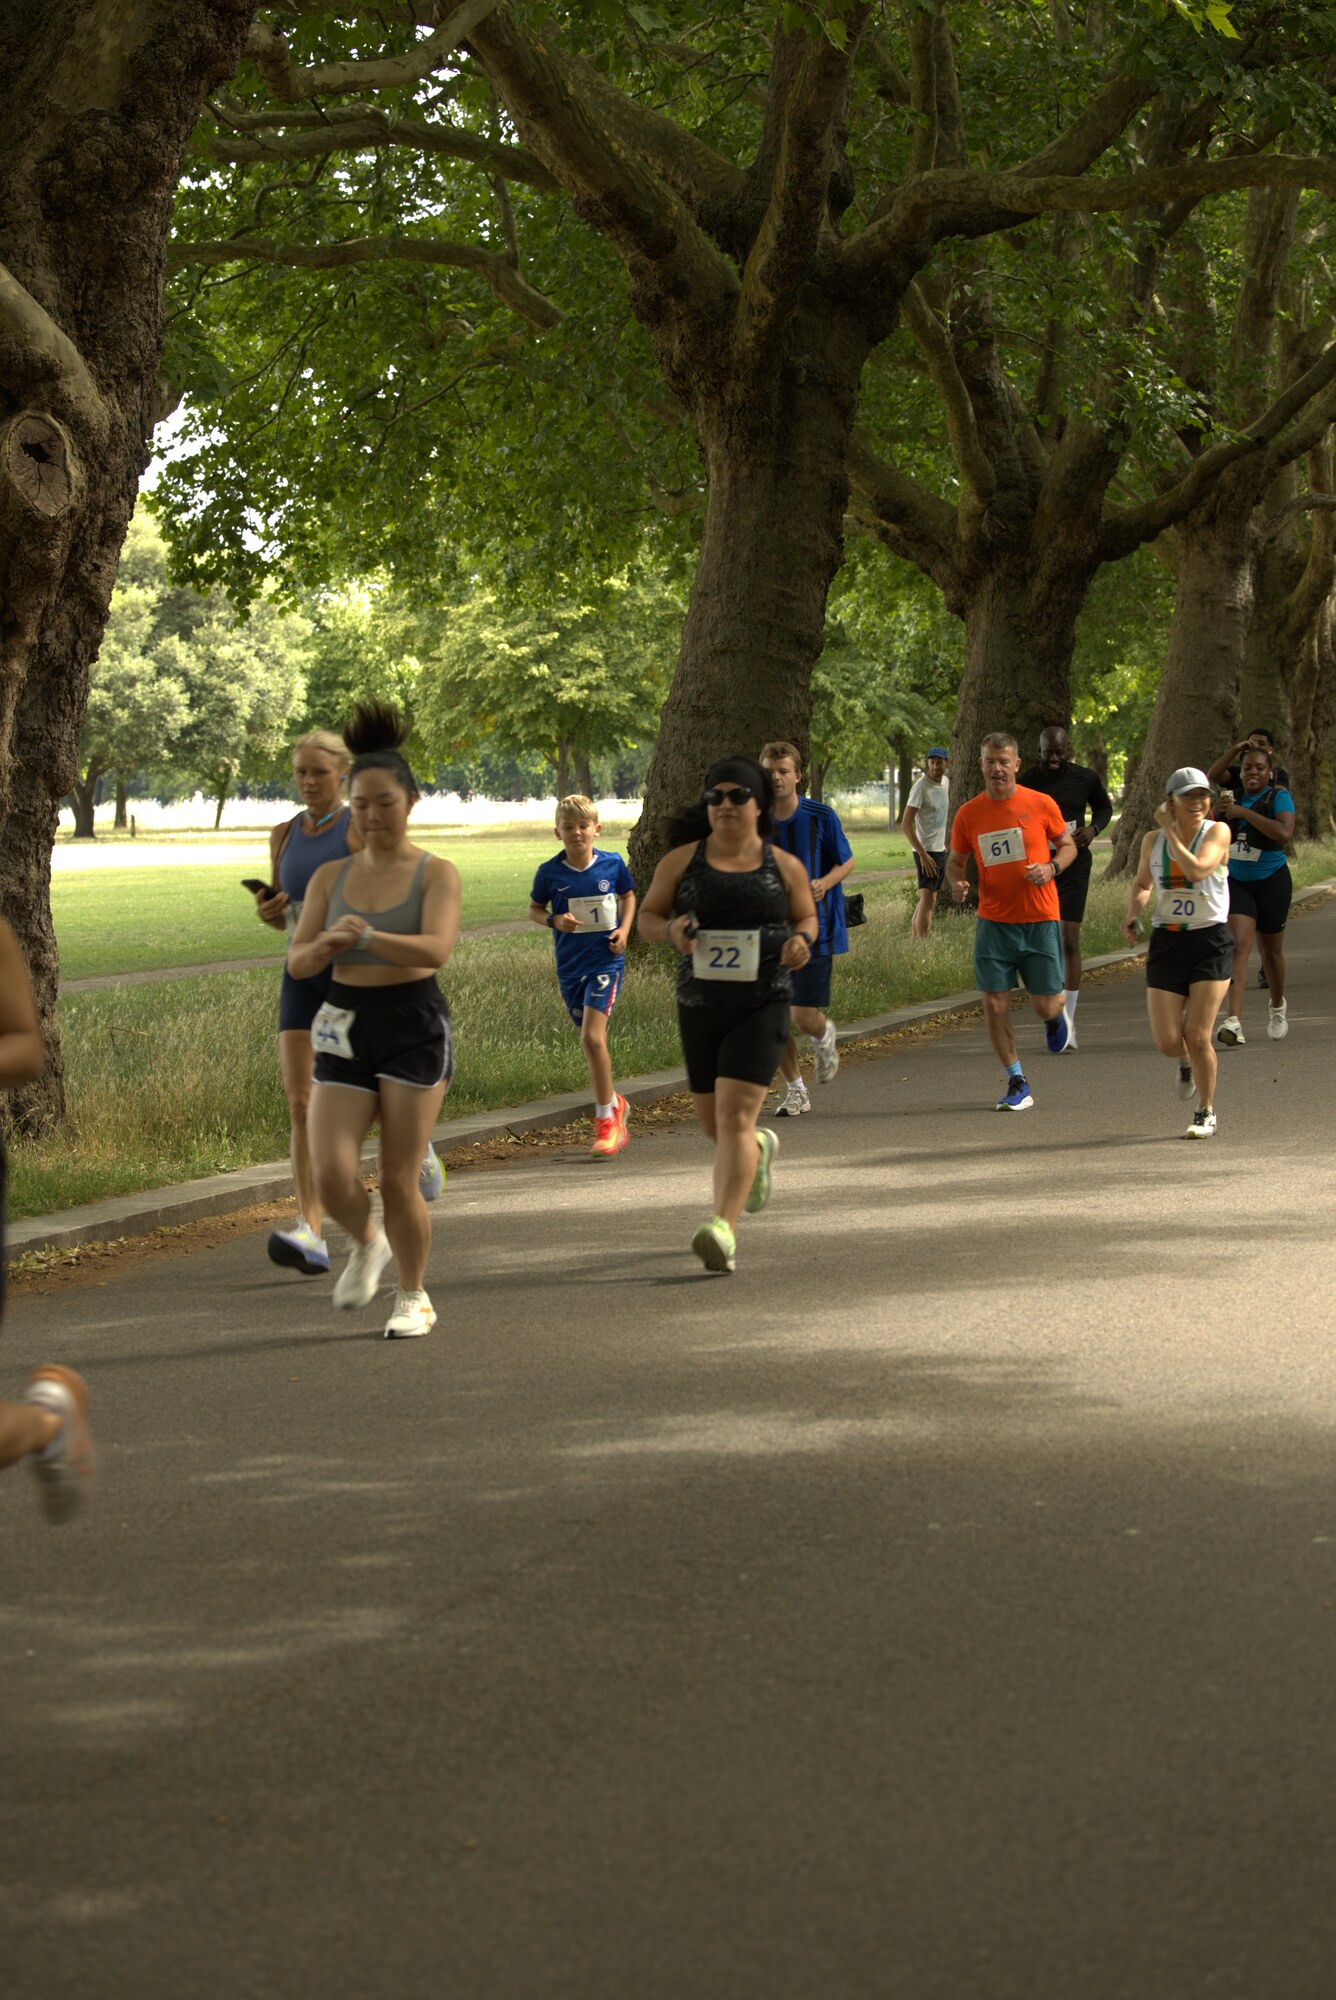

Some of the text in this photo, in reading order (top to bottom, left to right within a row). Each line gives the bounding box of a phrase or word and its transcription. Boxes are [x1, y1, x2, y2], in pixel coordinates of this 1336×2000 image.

[991, 840, 1011, 857] 61
[590, 907, 599, 923] 1
[1172, 899, 1195, 916] 20
[709, 946, 741, 968] 22
[597, 974, 610, 991] 9
